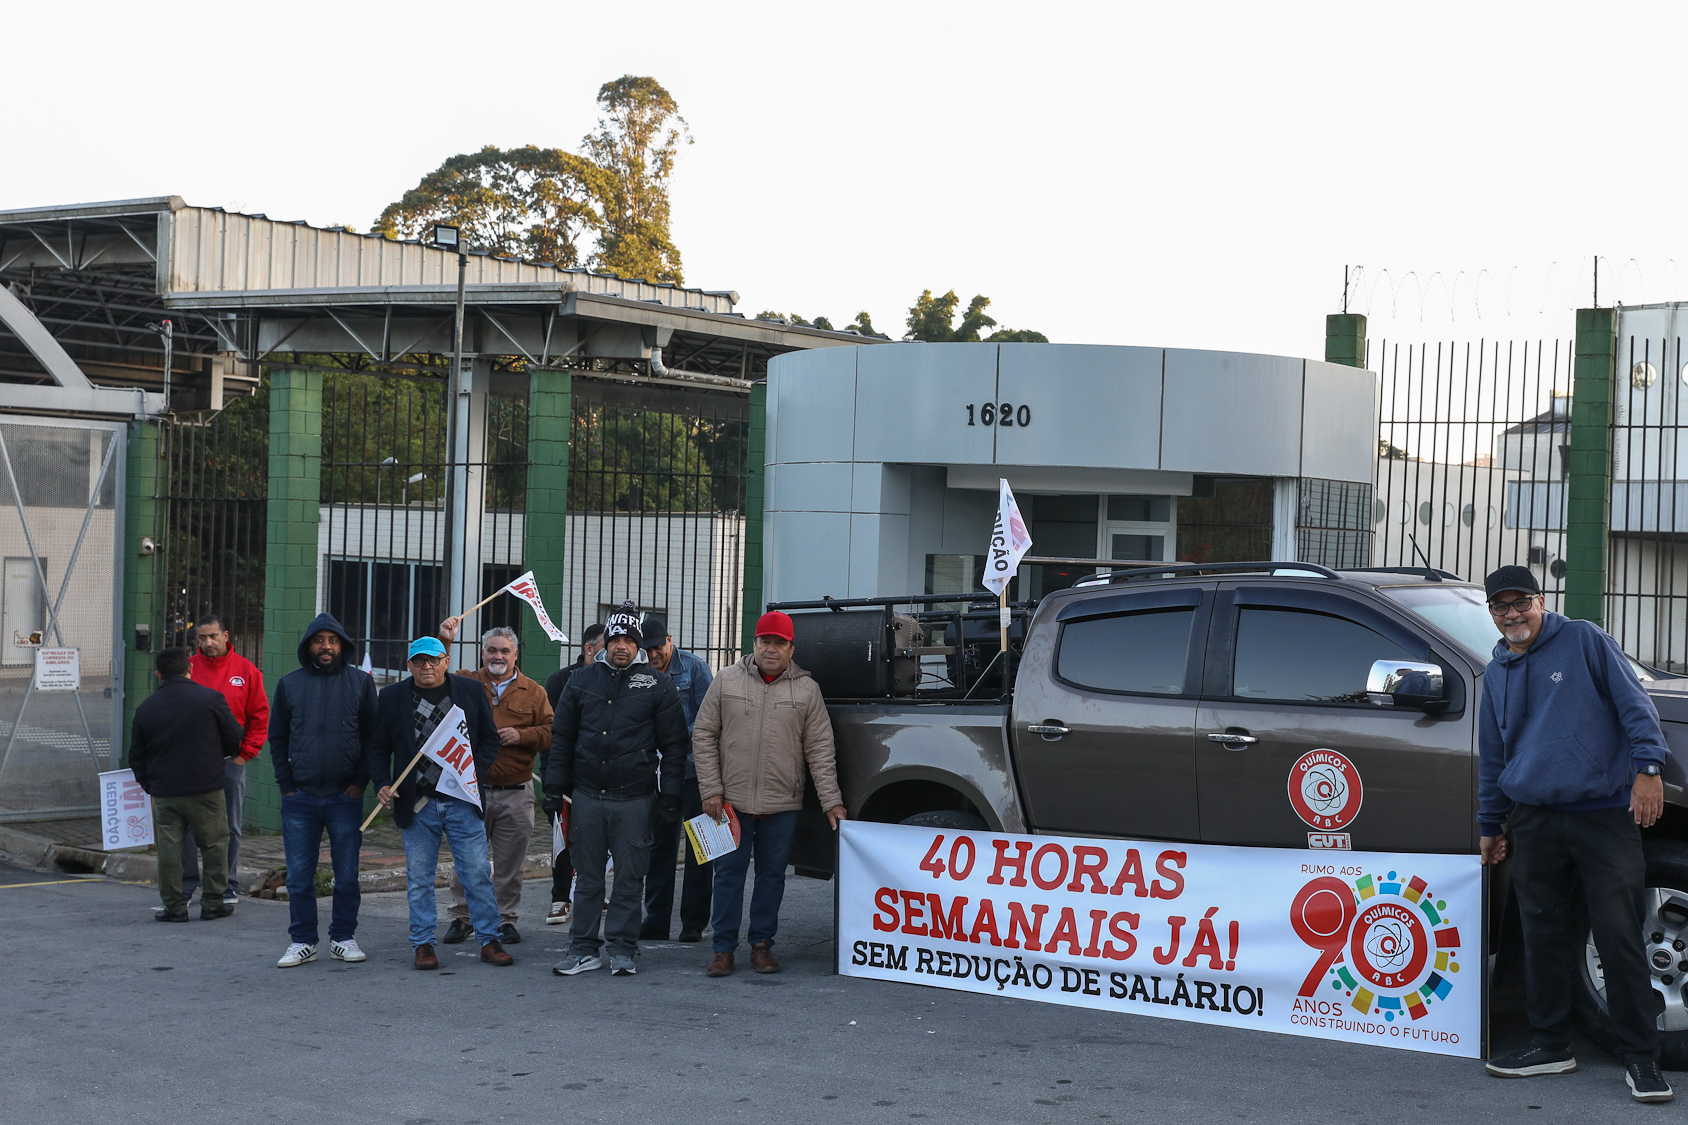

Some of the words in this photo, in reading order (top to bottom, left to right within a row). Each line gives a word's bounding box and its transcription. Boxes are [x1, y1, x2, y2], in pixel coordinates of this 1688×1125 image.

[966, 402, 1031, 427] 1620
[1299, 753, 1347, 772] QUÍMICOS
[1312, 814, 1342, 827] ABC
[1310, 834, 1346, 848] CUT
[919, 834, 976, 881] 40
[986, 839, 1187, 901] HORAS
[1301, 864, 1335, 875] RUMO
[1339, 867, 1362, 876] AOS
[1363, 905, 1415, 928] QUÍMICOS
[873, 886, 1140, 961] SEMANAIS
[1152, 906, 1239, 972] JÁ!
[852, 940, 909, 971] SEM
[915, 947, 1053, 991] REDUÇÃO
[1059, 966, 1101, 996] DE
[1109, 972, 1264, 1017] SALÁRIO!
[1371, 972, 1405, 986] ABC
[1292, 998, 1343, 1017] ANOS
[1290, 1014, 1386, 1035] CONSTRUINDO
[1390, 1026, 1399, 1037] O
[1403, 1027, 1460, 1044] FUTURO
